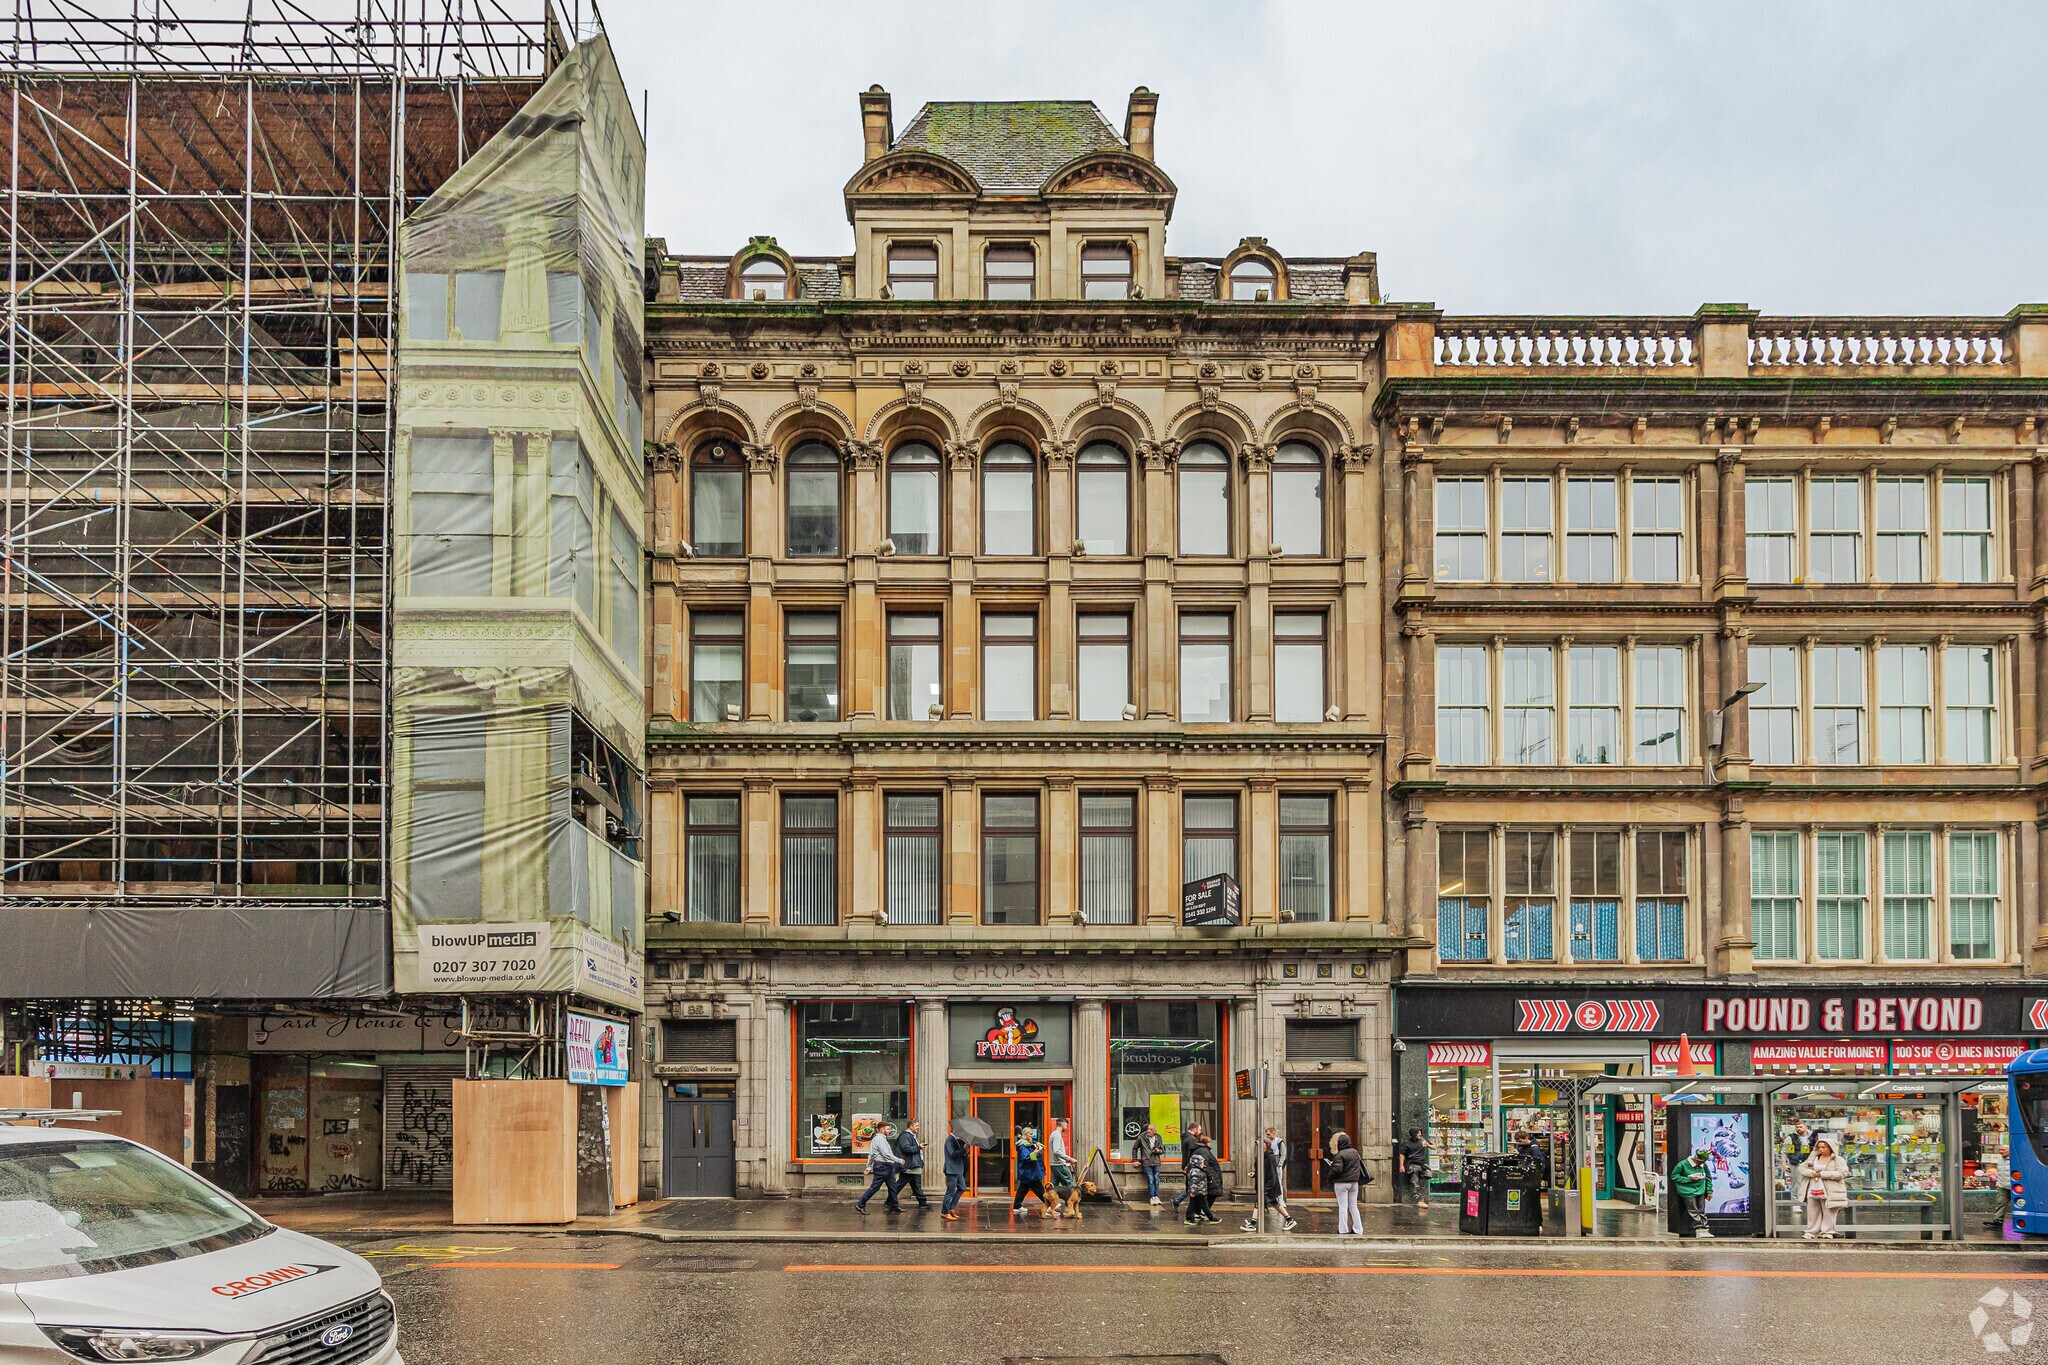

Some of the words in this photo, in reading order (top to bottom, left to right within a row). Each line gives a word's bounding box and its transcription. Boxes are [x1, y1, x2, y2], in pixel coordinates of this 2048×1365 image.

[1185, 894, 1196, 902] FOR
[1198, 890, 1211, 900] SALE
[431, 934, 486, 947] blowUP
[487, 931, 534, 947] media
[433, 961, 467, 973] 0207
[472, 960, 497, 972] 307
[501, 959, 536, 971] 7020
[953, 963, 1087, 981] CHOPSTIX
[433, 973, 536, 983] www.blowup-media.co.uk
[1318, 1004, 1334, 1015] 78
[1703, 997, 1811, 1032] POUND
[1821, 997, 1845, 1032] &
[1854, 997, 1983, 1032] BEYOND
[569, 1016, 591, 1045] REFILL
[977, 1041, 1045, 1057] FWOKX
[1753, 1046, 1797, 1058] AMAZING
[1798, 1046, 1828, 1058] VALUE
[1828, 1046, 1846, 1058] FOR
[1847, 1046, 1884, 1058] MONEY!
[1895, 1045, 1920, 1058] 100'S
[1921, 1046, 1933, 1058] OF
[1955, 1046, 1982, 1058] LINES
[1983, 1046, 1993, 1058] IN
[568, 1045, 596, 1070] STATION
[56, 1066, 79, 1075] ANY
[82, 1067, 87, 1076] 3
[690, 1065, 709, 1073] West
[710, 1065, 733, 1073] House
[1616, 1113, 1630, 1121] POUND
[1693, 1116, 1716, 1127] IT'S
[212, 1265, 308, 1297] CROWN
[328, 1326, 348, 1342] Ford
